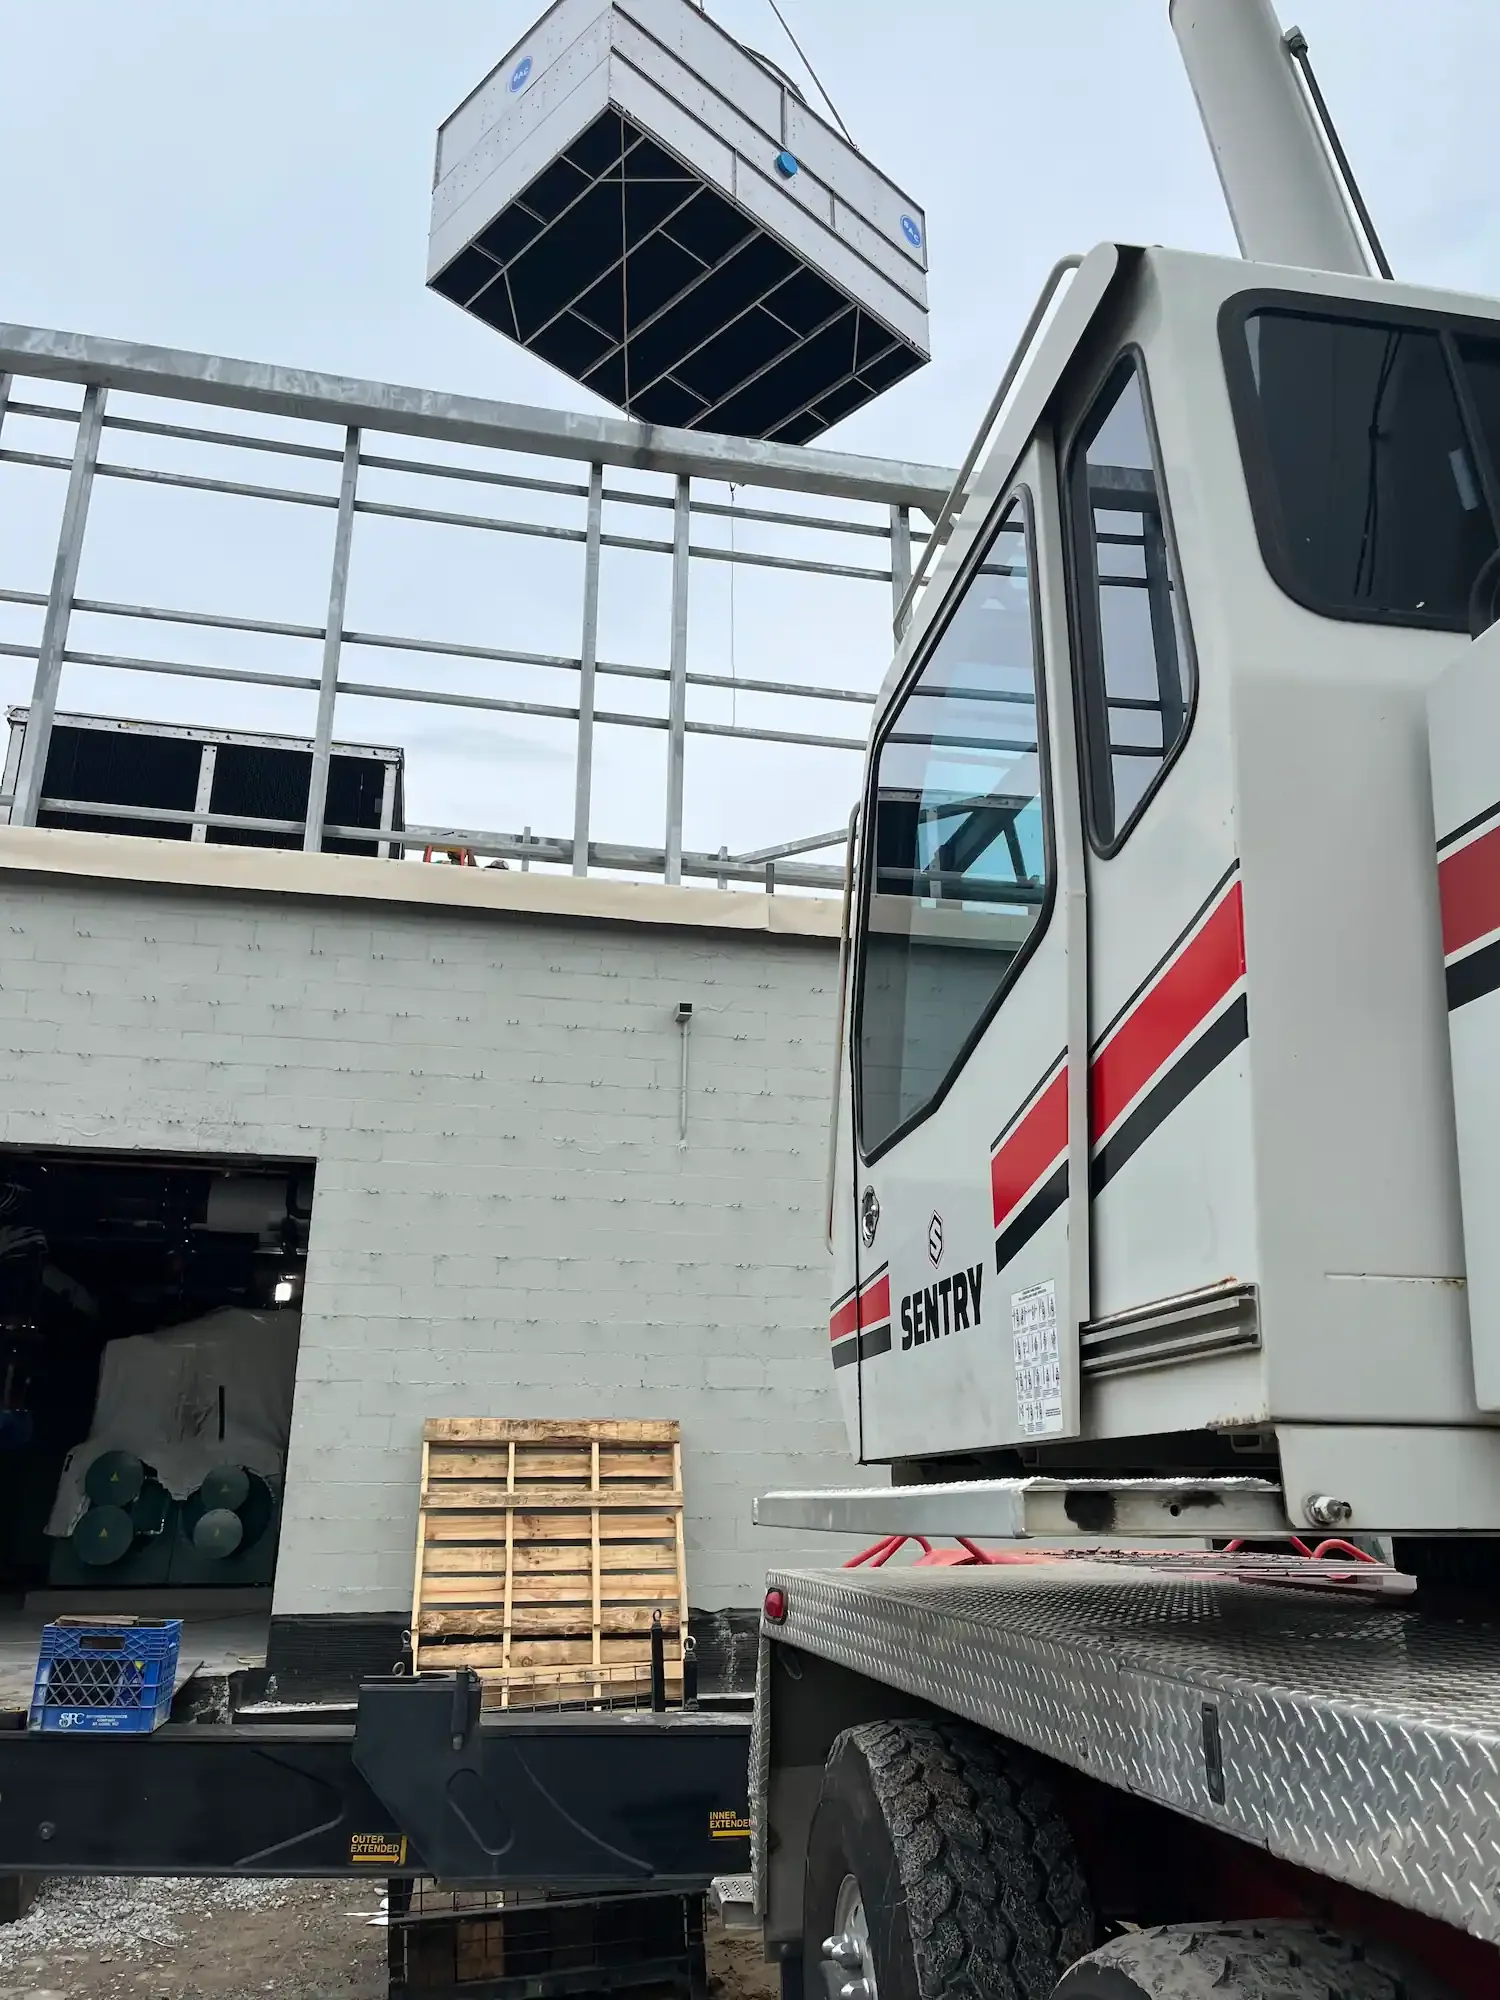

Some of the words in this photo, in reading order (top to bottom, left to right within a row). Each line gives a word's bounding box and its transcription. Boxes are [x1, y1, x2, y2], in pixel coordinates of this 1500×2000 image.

[901, 1262, 983, 1351] SENTRY
[709, 1811, 737, 1820] INNER
[351, 1834, 384, 1844] OUTER
[350, 1843, 400, 1853] EXTENDED
